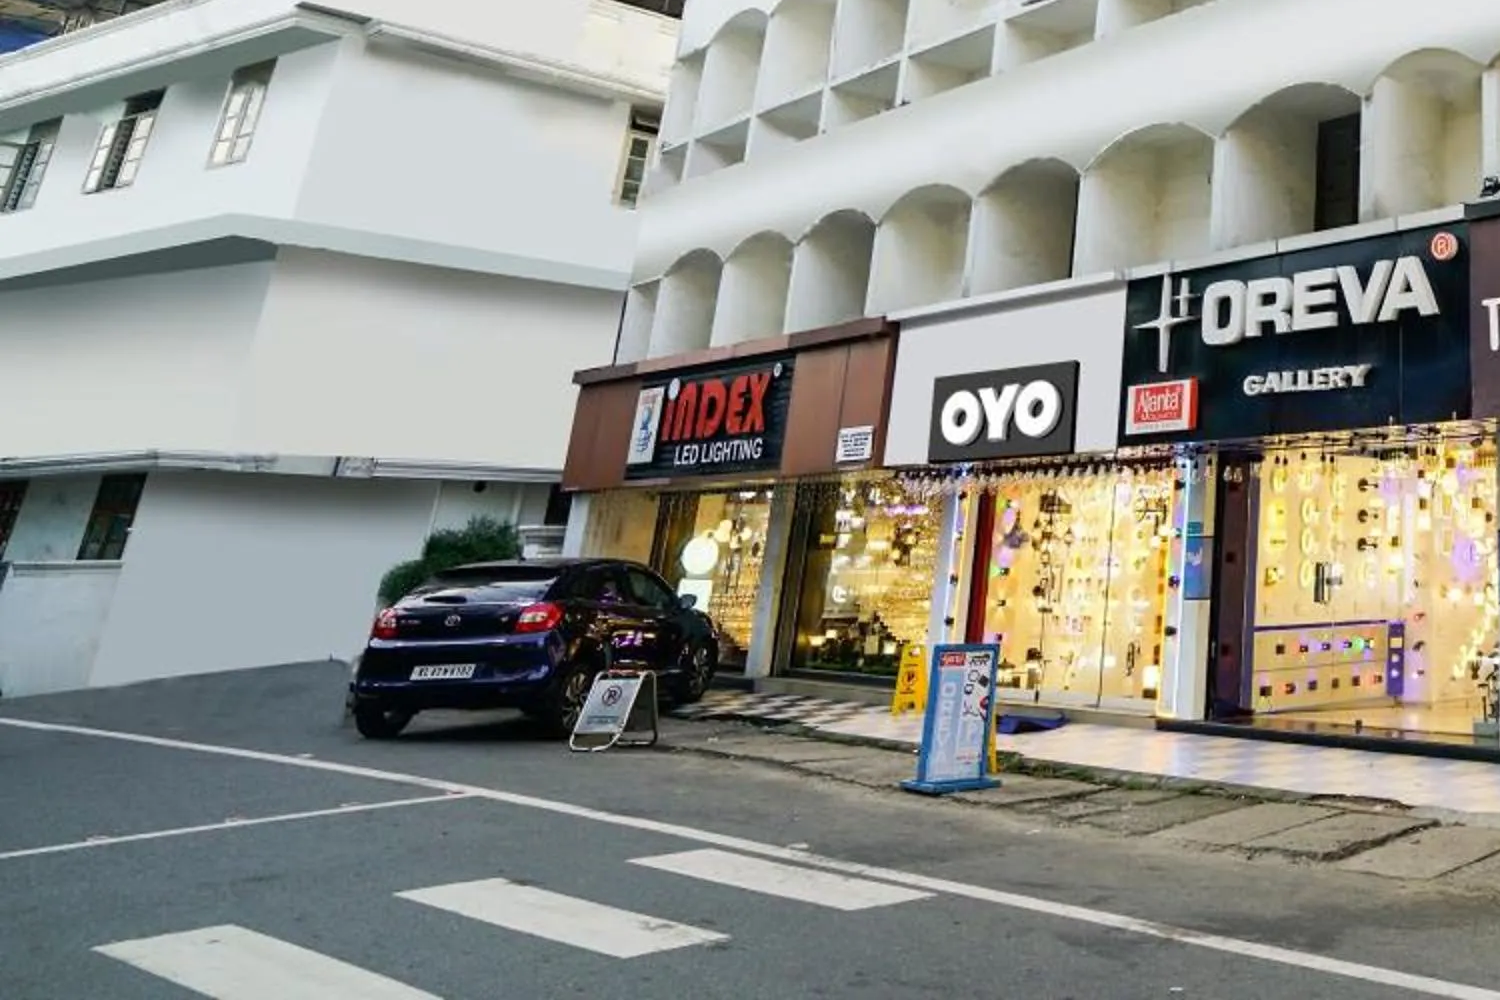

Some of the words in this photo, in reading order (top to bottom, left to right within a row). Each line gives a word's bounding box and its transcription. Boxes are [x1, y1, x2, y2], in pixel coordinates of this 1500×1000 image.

[1201, 254, 1440, 346] OREVA
[1242, 362, 1374, 397] GALLERY
[941, 379, 1062, 446] OYO
[673, 443, 699, 466] LED
[701, 437, 764, 463] LIGHTING
